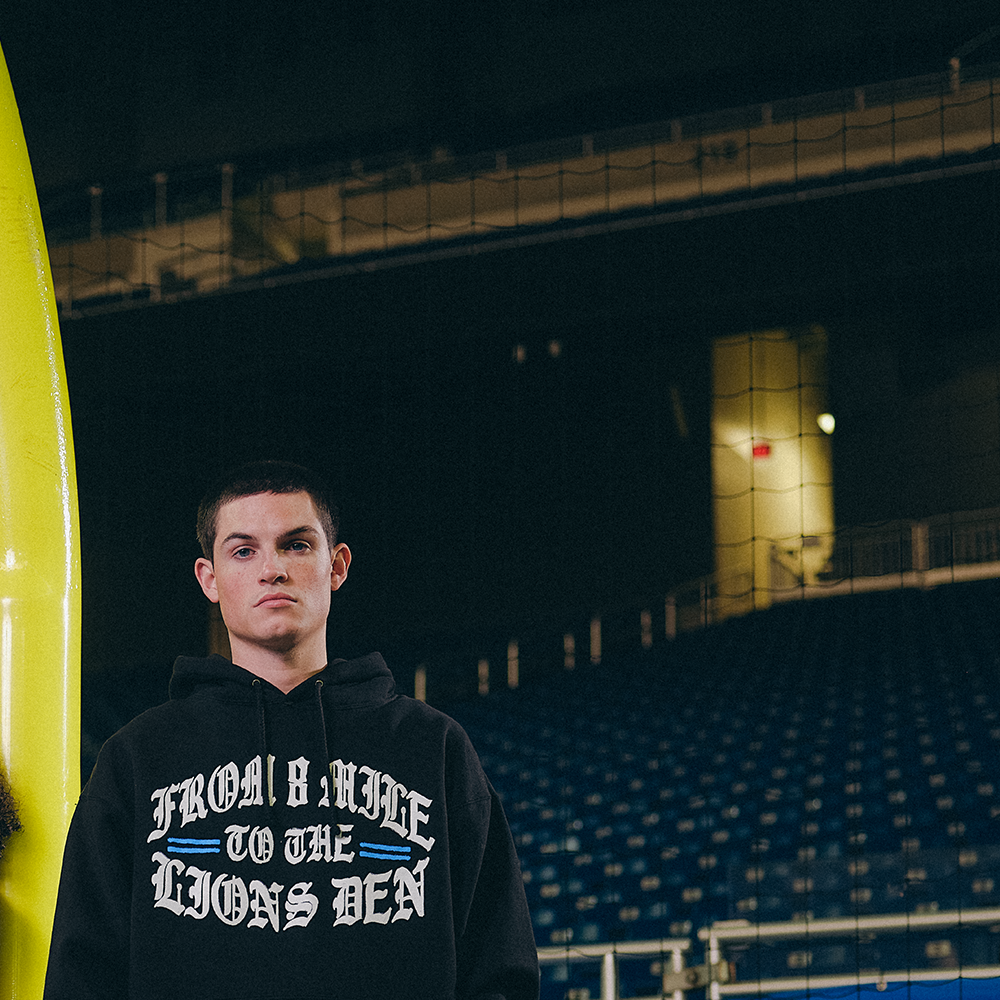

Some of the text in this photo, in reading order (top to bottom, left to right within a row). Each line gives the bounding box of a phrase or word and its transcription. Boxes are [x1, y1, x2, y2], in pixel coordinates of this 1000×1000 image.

[146, 753, 436, 852] FROM 8 MILE
[223, 823, 356, 865] TO THE
[150, 851, 431, 933] LIONS DEN
